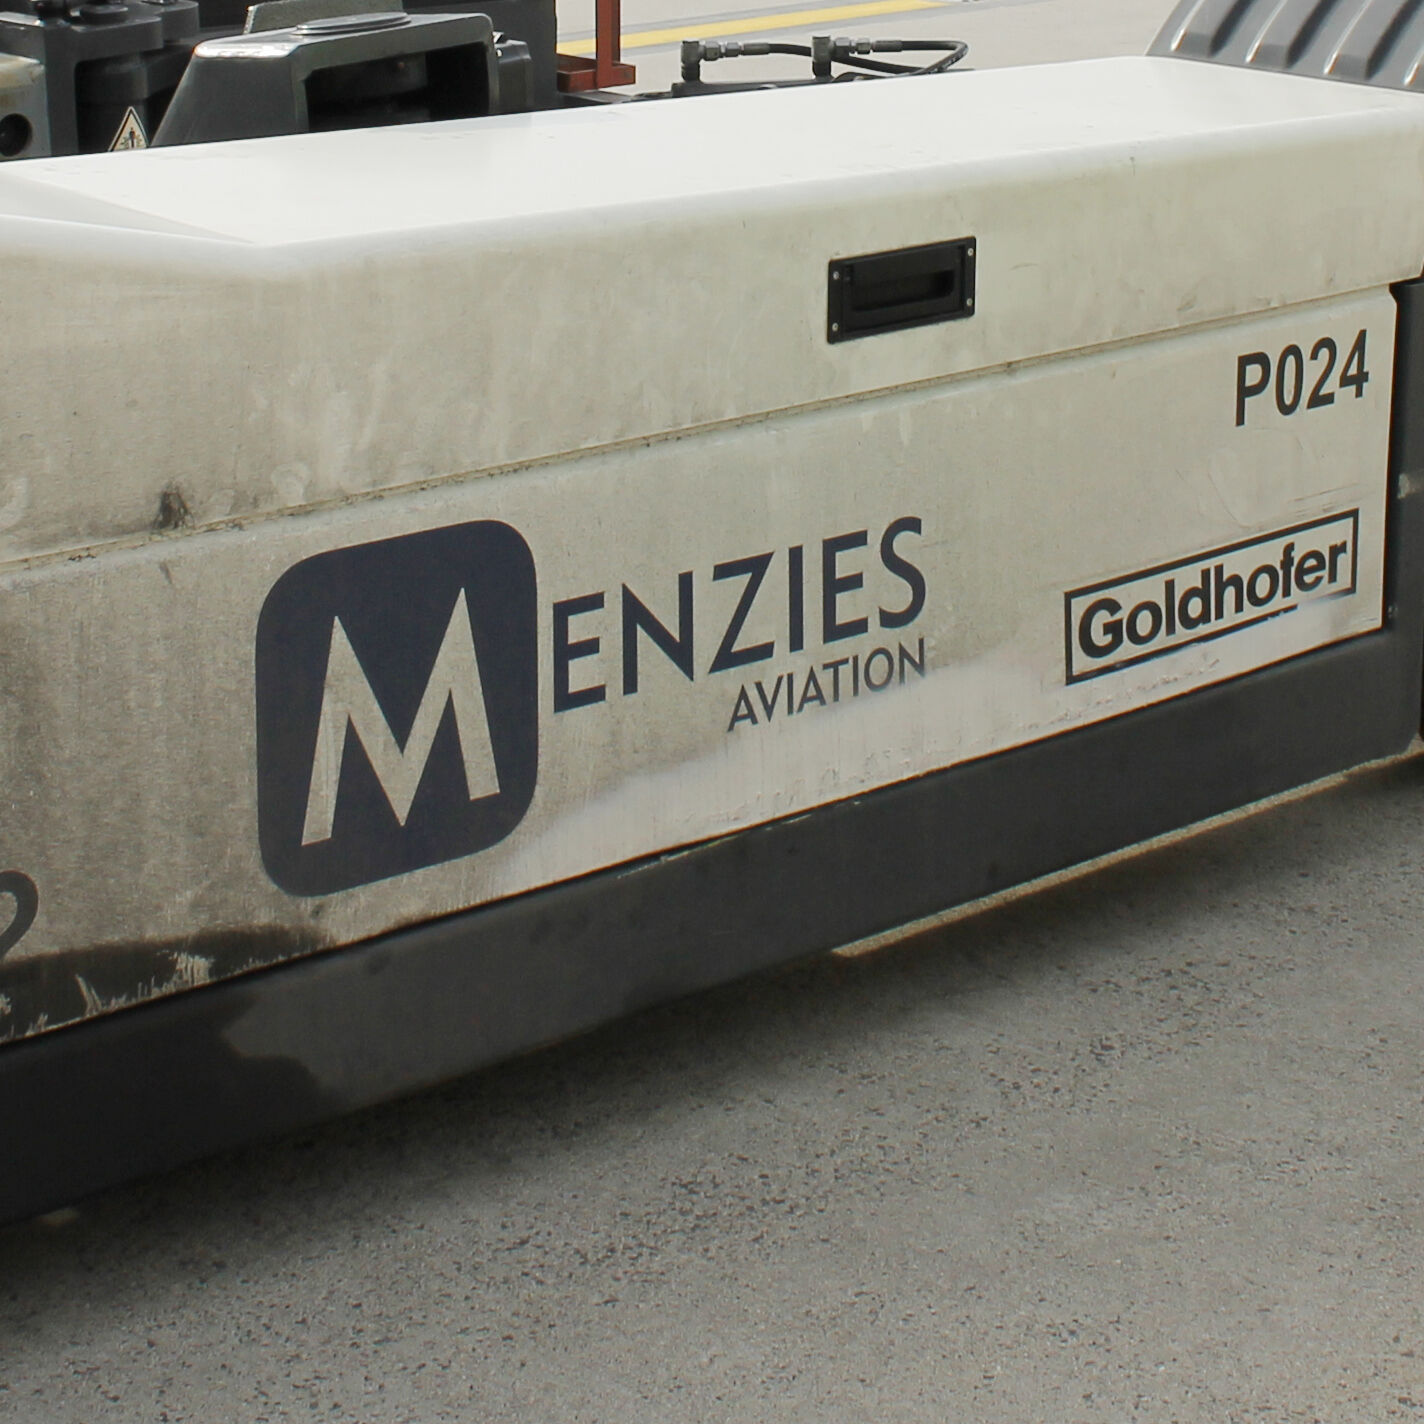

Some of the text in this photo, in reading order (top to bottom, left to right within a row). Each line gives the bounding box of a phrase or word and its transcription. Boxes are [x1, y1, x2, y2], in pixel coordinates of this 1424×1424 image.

[1235, 329, 1370, 427] P024
[1078, 540, 1347, 660] Goldhofer
[727, 637, 927, 732] AVIATION
